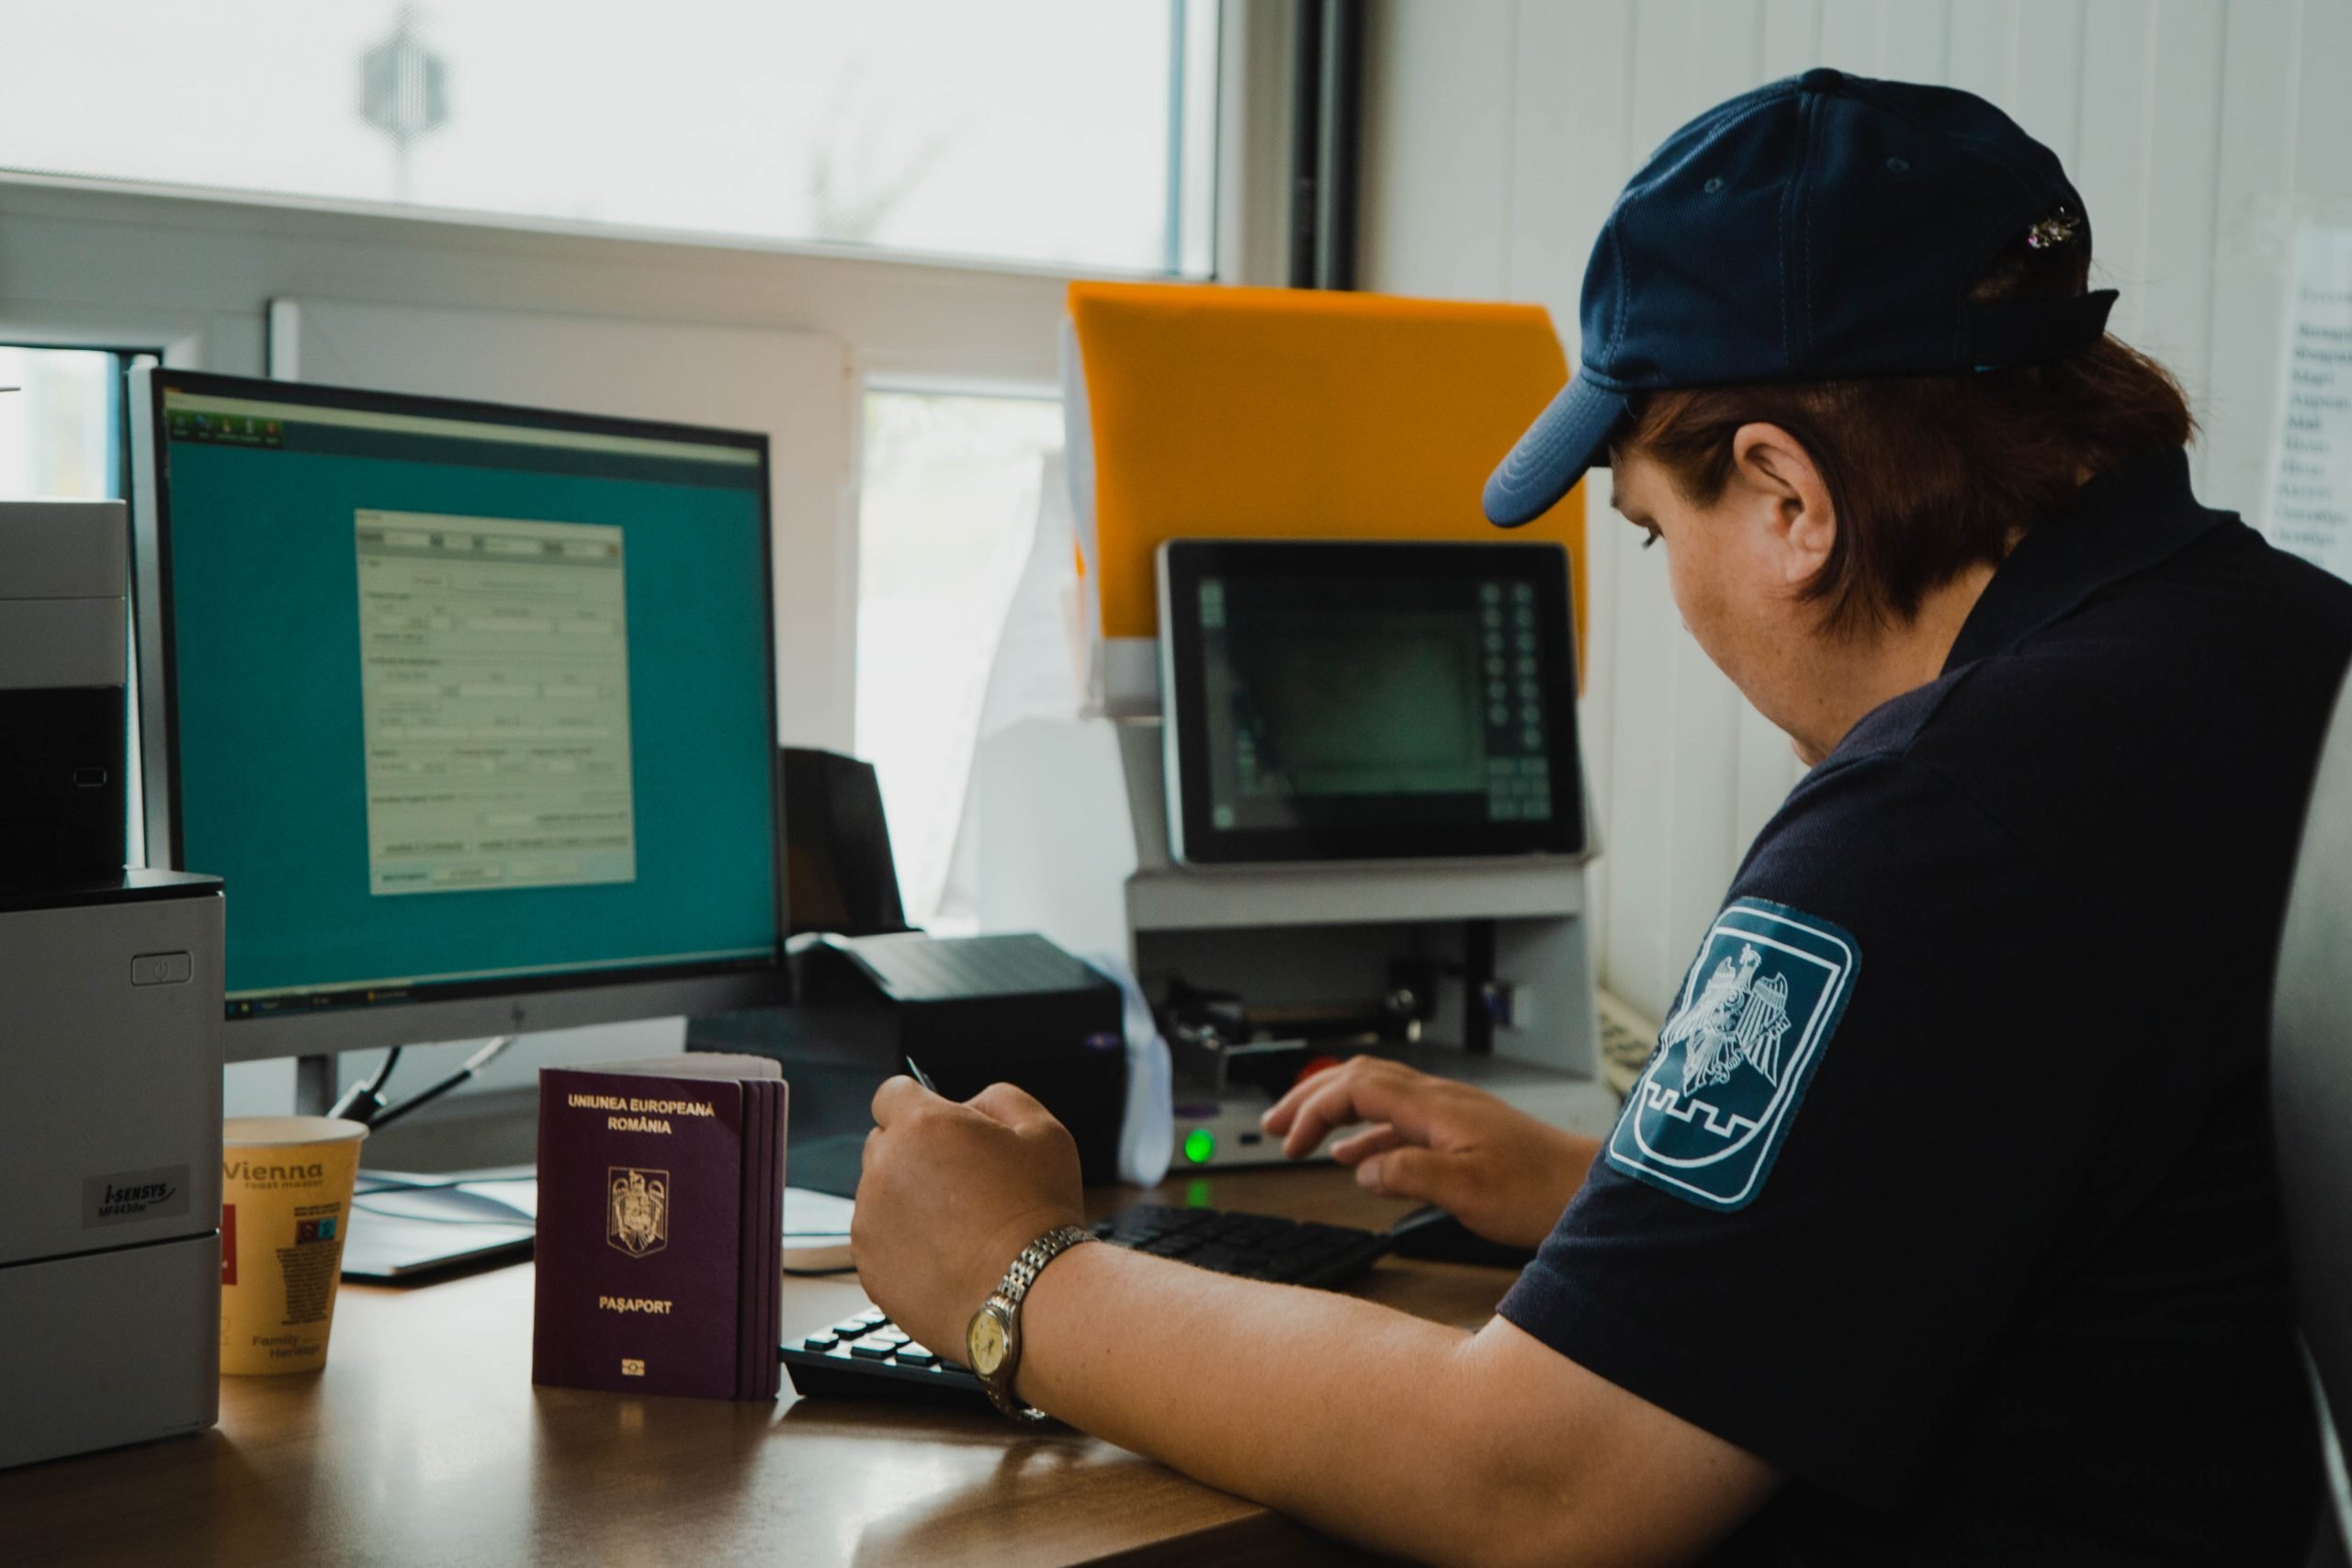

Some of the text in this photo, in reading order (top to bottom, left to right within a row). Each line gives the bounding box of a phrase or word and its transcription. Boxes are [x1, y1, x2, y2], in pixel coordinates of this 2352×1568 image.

[568, 1093, 627, 1111] UNIUNEA
[608, 1116, 673, 1134] ROMÂNIA
[223, 1161, 323, 1180] Vienna
[105, 1183, 167, 1203] i-SENSYS
[253, 1334, 300, 1348] Family
